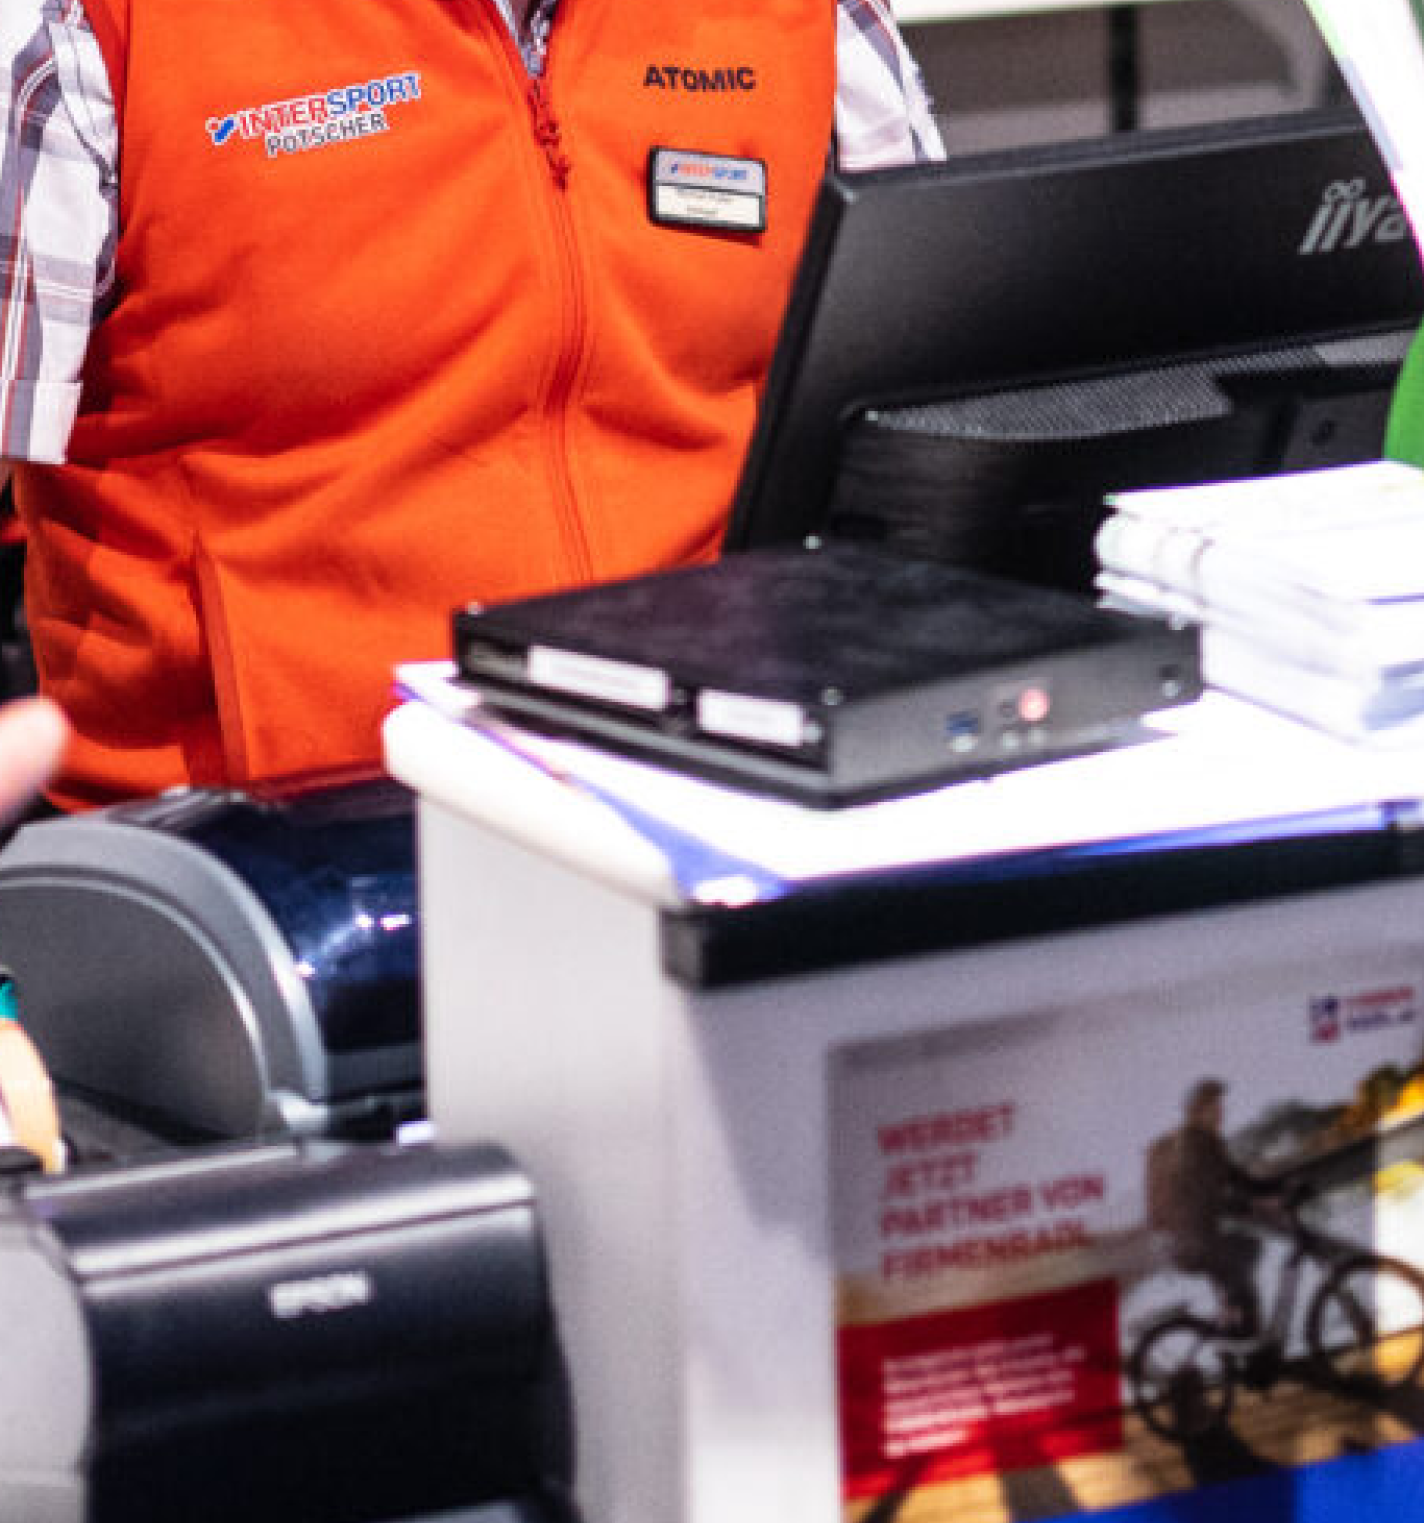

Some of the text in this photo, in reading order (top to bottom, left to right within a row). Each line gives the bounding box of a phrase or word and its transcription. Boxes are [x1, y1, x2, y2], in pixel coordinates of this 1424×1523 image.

[239, 72, 420, 139] INTERSPORT
[643, 63, 757, 93] ATOMIC
[1297, 176, 1408, 256] iiya
[877, 1101, 1015, 1156] WERDET
[883, 1149, 978, 1199] JETZT
[880, 1170, 1106, 1240] PARTNER VON
